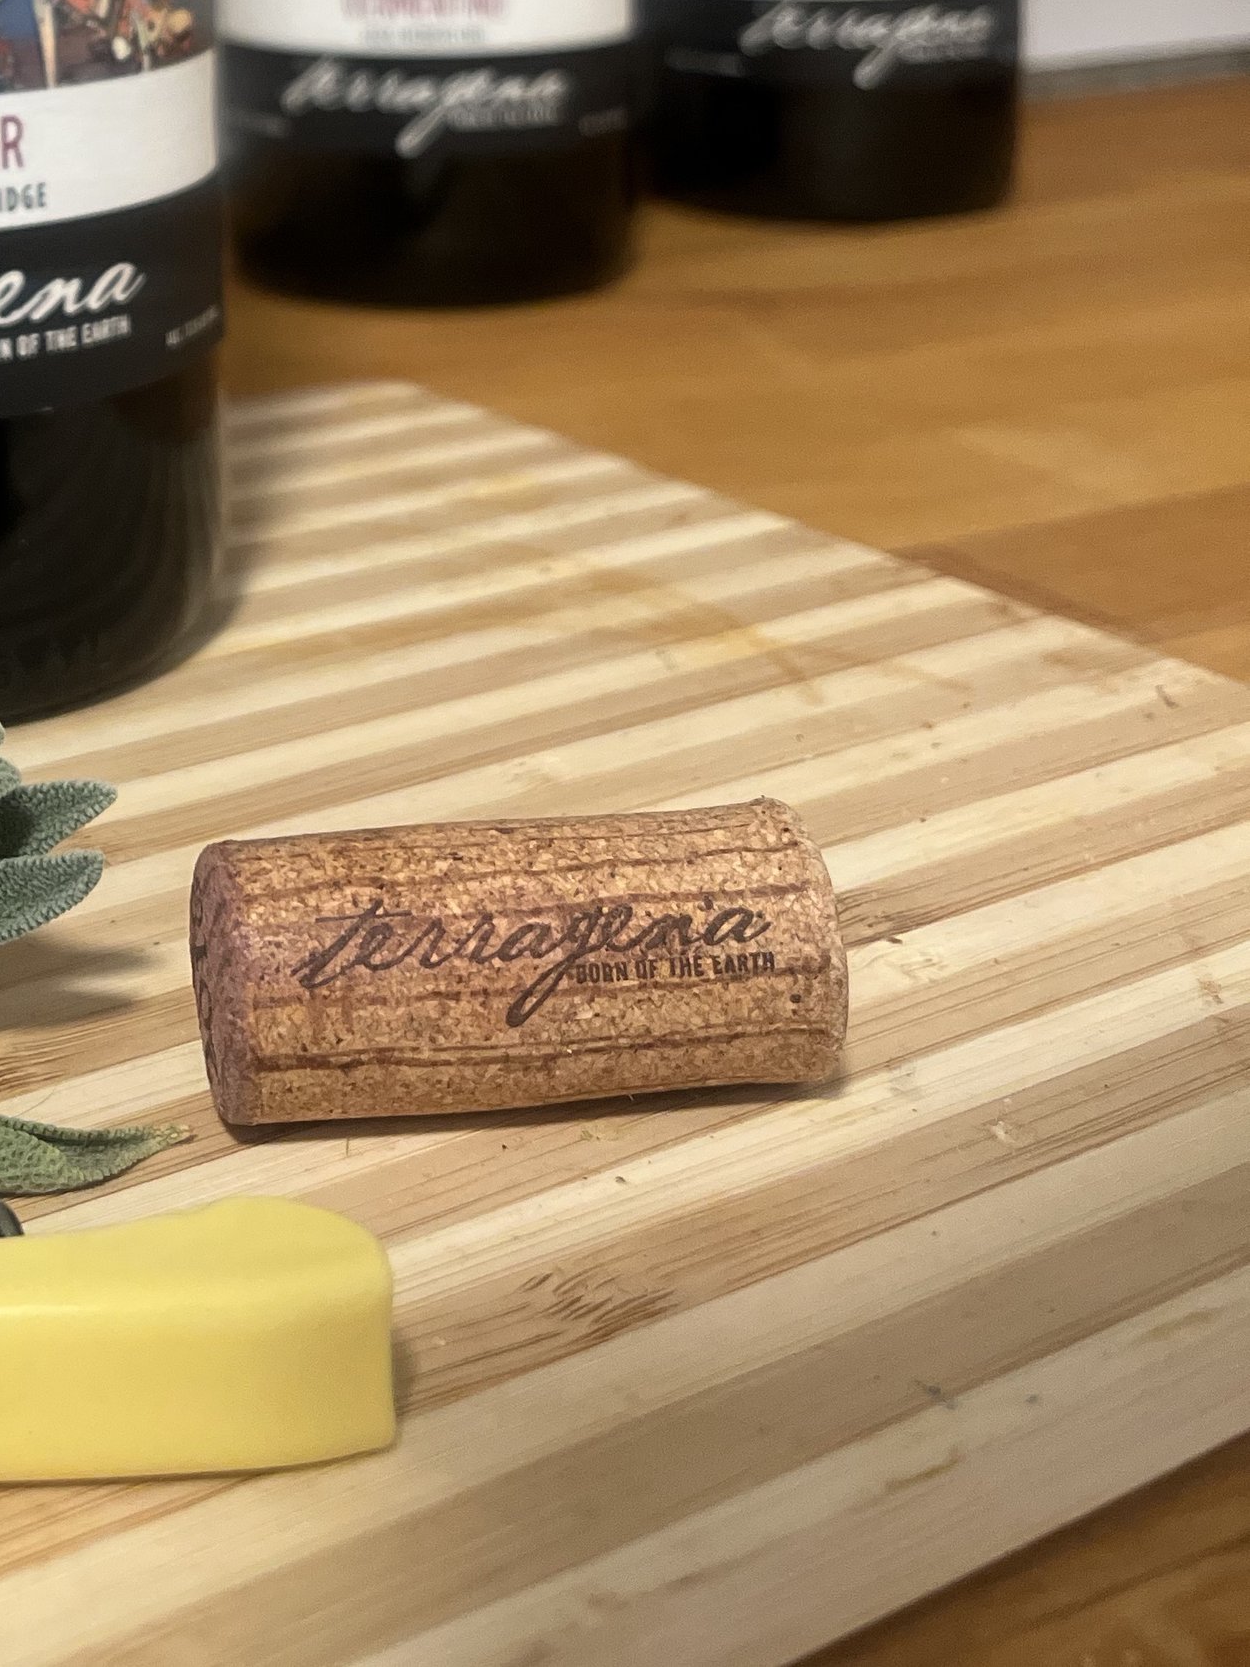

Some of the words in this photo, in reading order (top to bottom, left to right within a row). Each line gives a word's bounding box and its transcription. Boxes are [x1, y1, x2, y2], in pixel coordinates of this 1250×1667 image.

[291, 896, 772, 1028] terragena
[575, 960, 629, 985] BORN
[634, 958, 661, 981] OF
[668, 953, 706, 979] THE
[710, 950, 776, 976] EARTH
